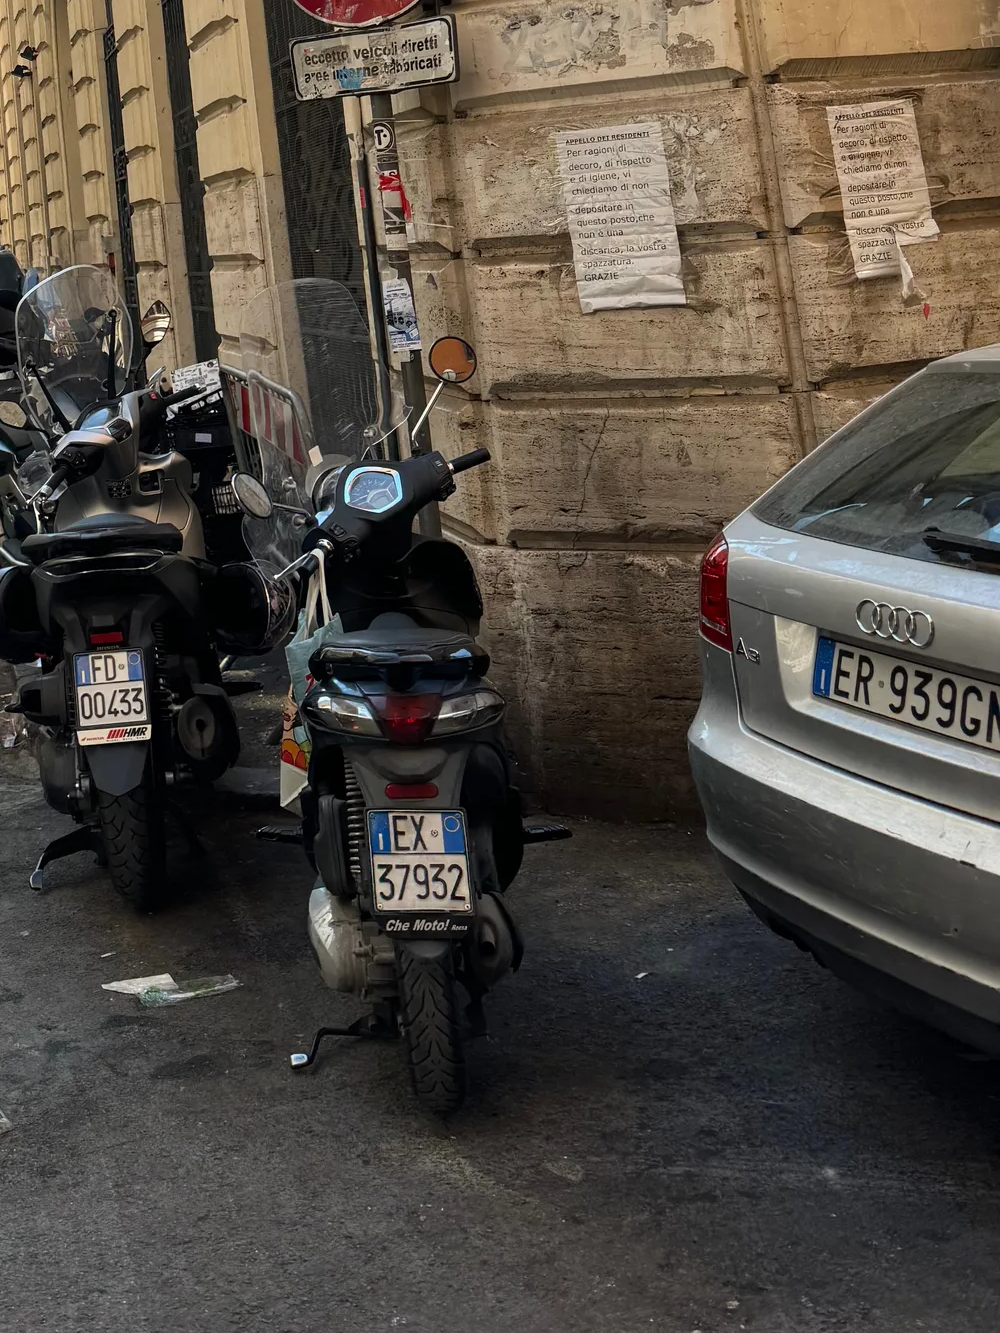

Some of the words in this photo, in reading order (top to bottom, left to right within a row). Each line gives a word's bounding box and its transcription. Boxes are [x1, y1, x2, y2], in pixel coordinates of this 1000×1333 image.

[304, 49, 349, 66] eccetto
[353, 41, 398, 60] veicoli
[401, 35, 438, 53] diretti
[304, 71, 330, 84] aree
[835, 113, 860, 121] APPELLO
[837, 125, 849, 134] Per
[851, 122, 878, 133] ragioni
[565, 136, 595, 145] APPELLO
[611, 131, 650, 140] RESIDENTI
[839, 139, 867, 148] decoro,
[870, 135, 876, 144] di
[879, 133, 907, 144] rispetto
[567, 149, 581, 157] Per
[584, 146, 615, 157] ragioni
[618, 144, 626, 152] di
[885, 148, 892, 156] vi
[569, 162, 602, 171] decoro,
[605, 158, 613, 167] di
[616, 156, 651, 166] rispetto
[844, 163, 881, 174] chiediamo
[884, 161, 891, 169] di
[578, 174, 586, 182] di
[589, 172, 620, 182] igiene,
[622, 170, 631, 178] vi
[572, 185, 618, 195] chiediamo
[620, 183, 628, 191] di
[848, 181, 887, 193] depositare
[850, 196, 875, 206] questo
[575, 204, 622, 214] depositare
[851, 210, 866, 218] non
[876, 208, 890, 216] una
[577, 218, 607, 227] questo
[901, 221, 924, 230] vostra
[598, 228, 604, 237] è
[581, 246, 624, 256] discarica,
[626, 244, 634, 252] la
[638, 242, 667, 251] vostra
[582, 258, 634, 269] spazzatura.
[860, 252, 892, 263] GRAZIE
[584, 272, 619, 282] GRAZIE
[91, 654, 117, 682] FD
[834, 648, 874, 706] ER
[888, 665, 1000, 743] 939GN
[80, 688, 144, 720] 00433
[123, 727, 148, 738] HMR
[392, 815, 427, 851] EX
[377, 863, 466, 901] 37932
[386, 919, 410, 932] Che
[412, 918, 450, 932] Moto!
